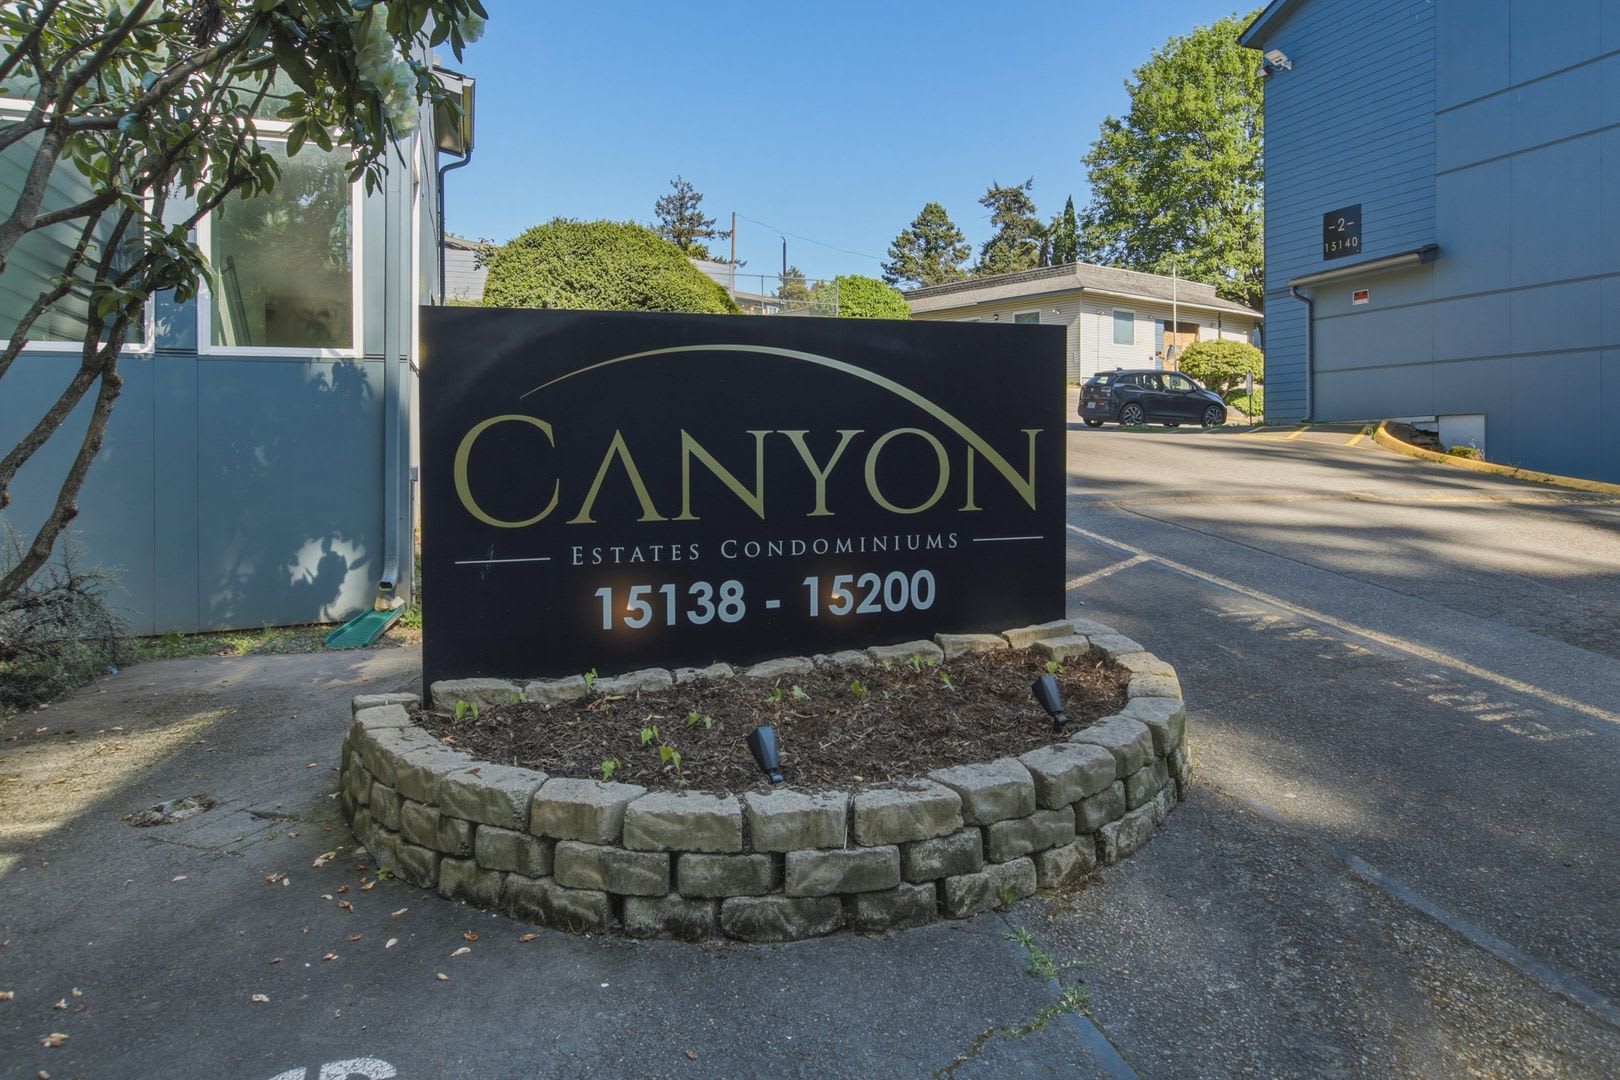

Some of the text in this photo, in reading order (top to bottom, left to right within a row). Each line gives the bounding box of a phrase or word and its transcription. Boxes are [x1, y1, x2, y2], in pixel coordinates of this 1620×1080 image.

[1325, 236, 1359, 252] 15140
[454, 413, 1044, 529] CANYON
[571, 532, 959, 567] ESTATES CONDOMINIUMS
[594, 580, 747, 631] 15138
[803, 569, 936, 617] 15200
